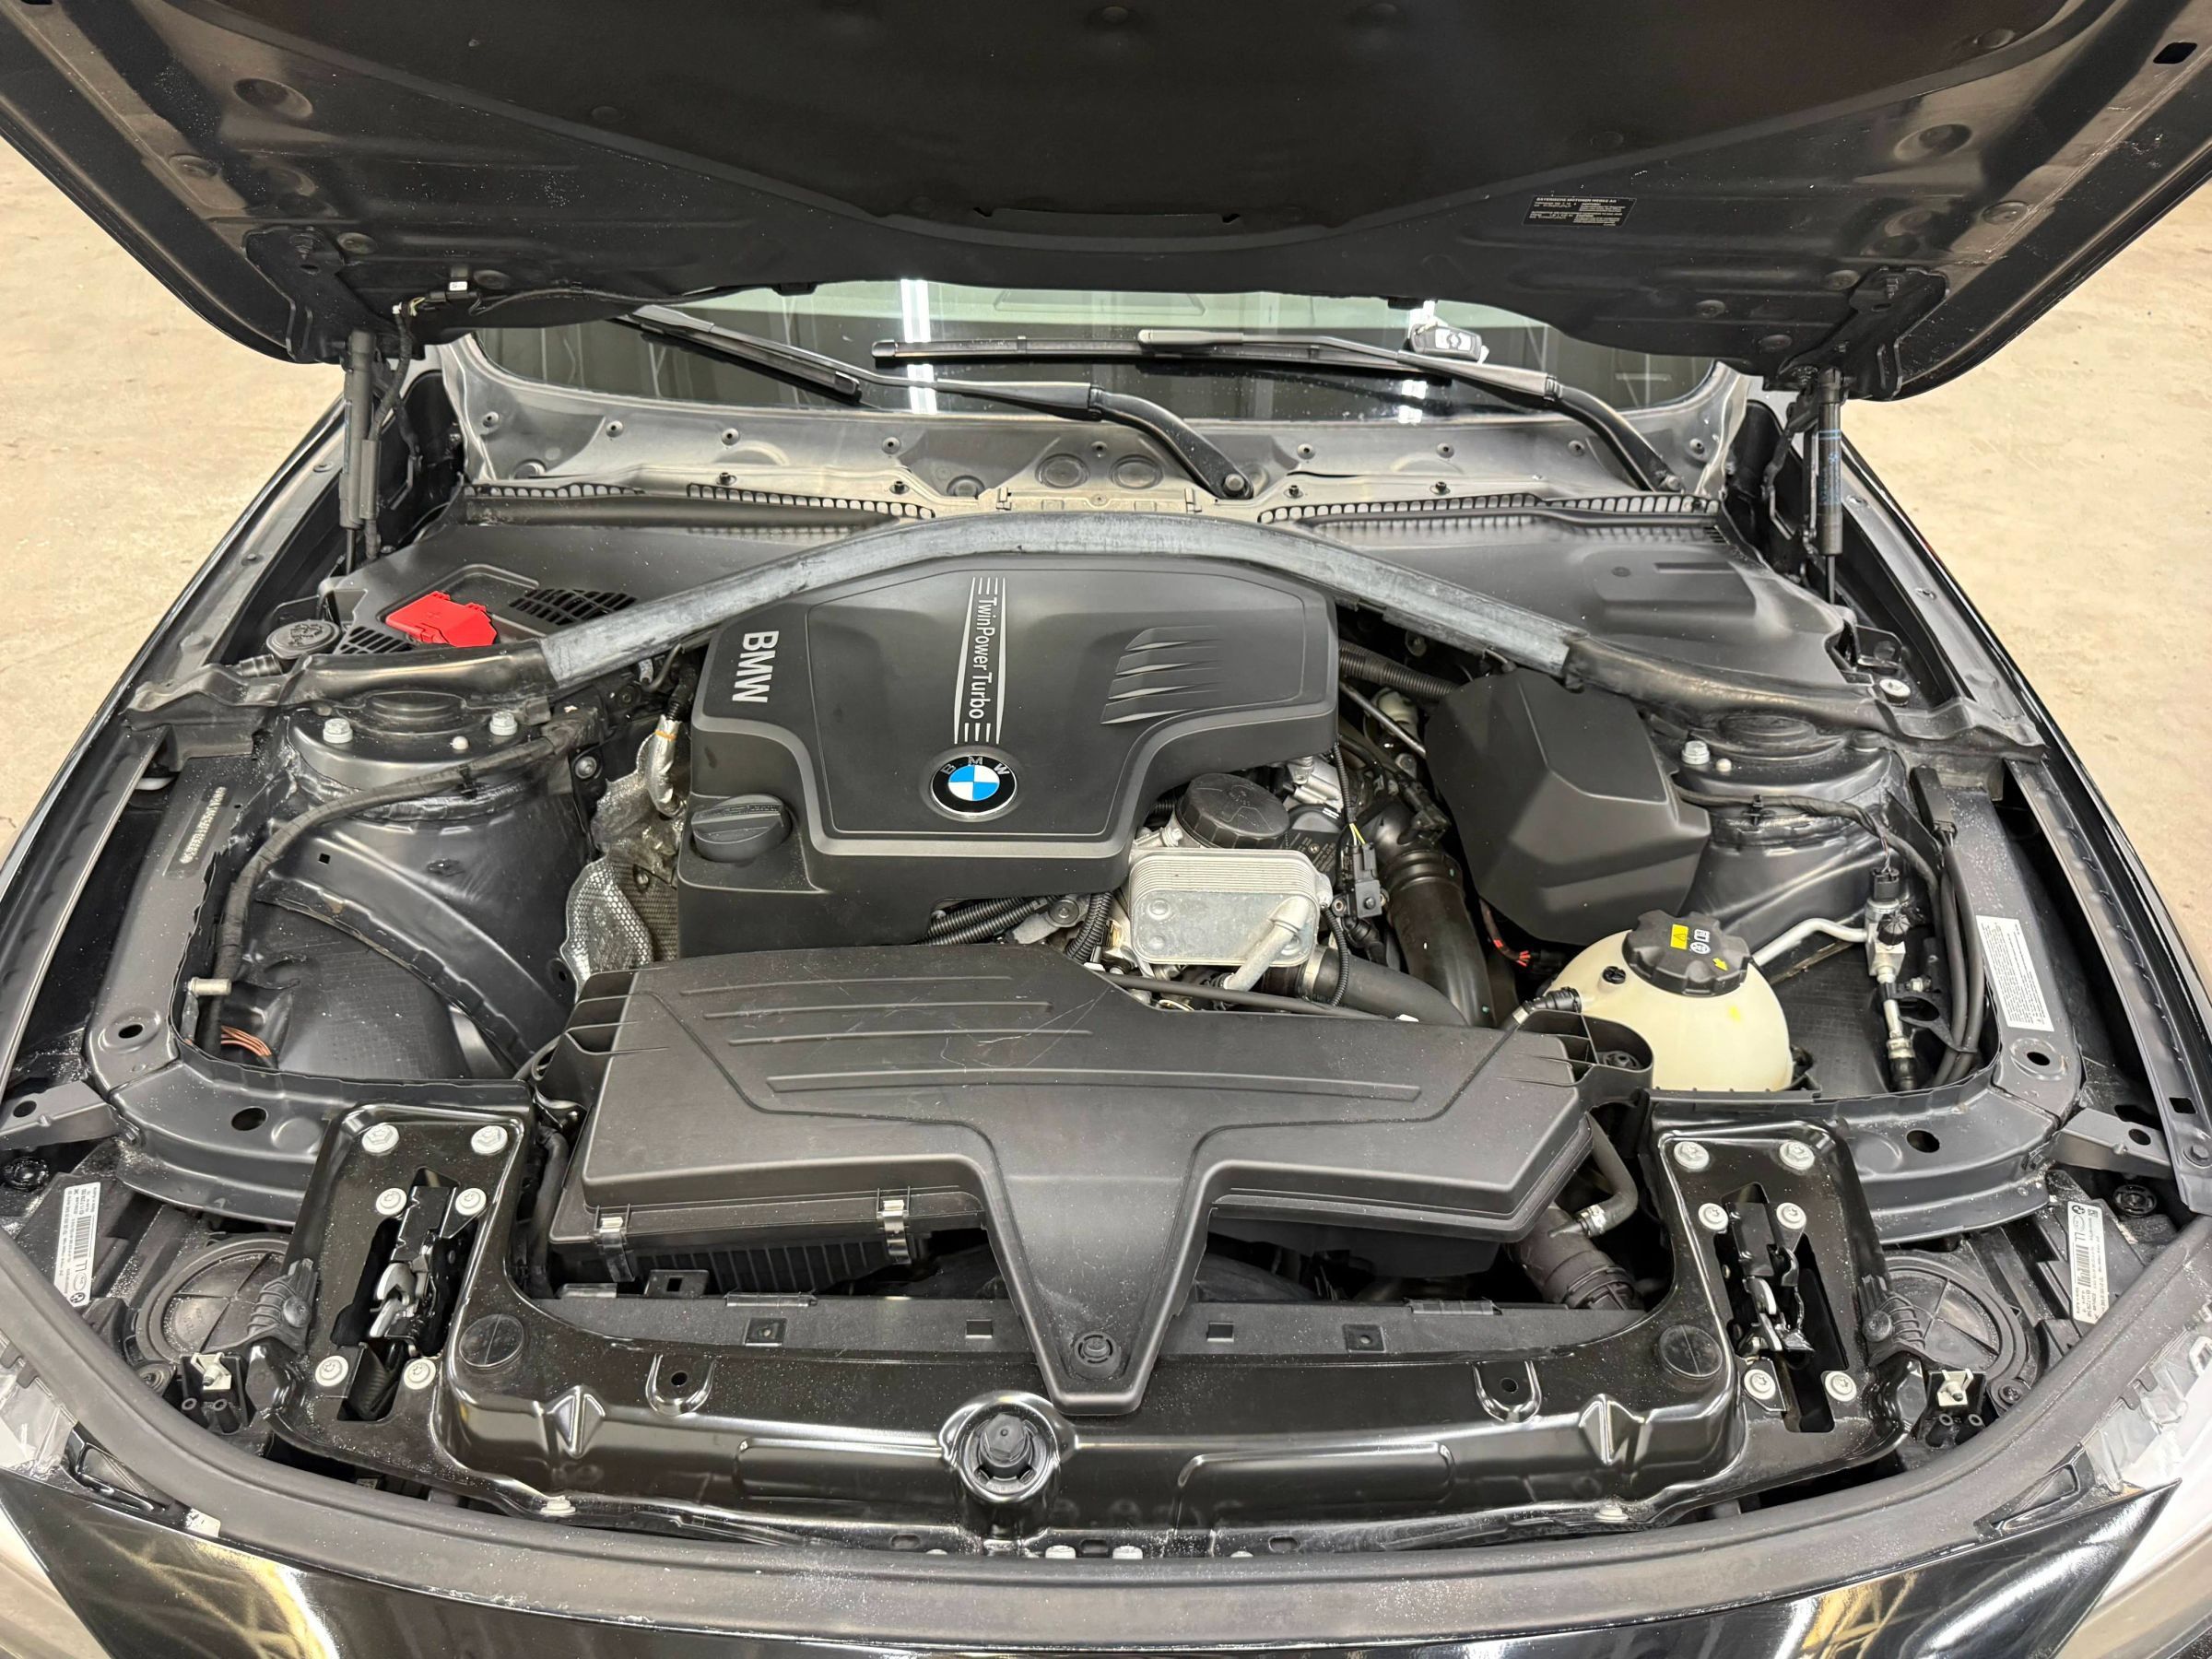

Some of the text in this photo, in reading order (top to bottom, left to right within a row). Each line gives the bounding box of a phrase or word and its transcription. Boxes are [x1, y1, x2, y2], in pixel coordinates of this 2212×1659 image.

[731, 630, 779, 703] BMW
[968, 596, 997, 719] TwinPower Turbo
[940, 756, 1010, 775] BMW
